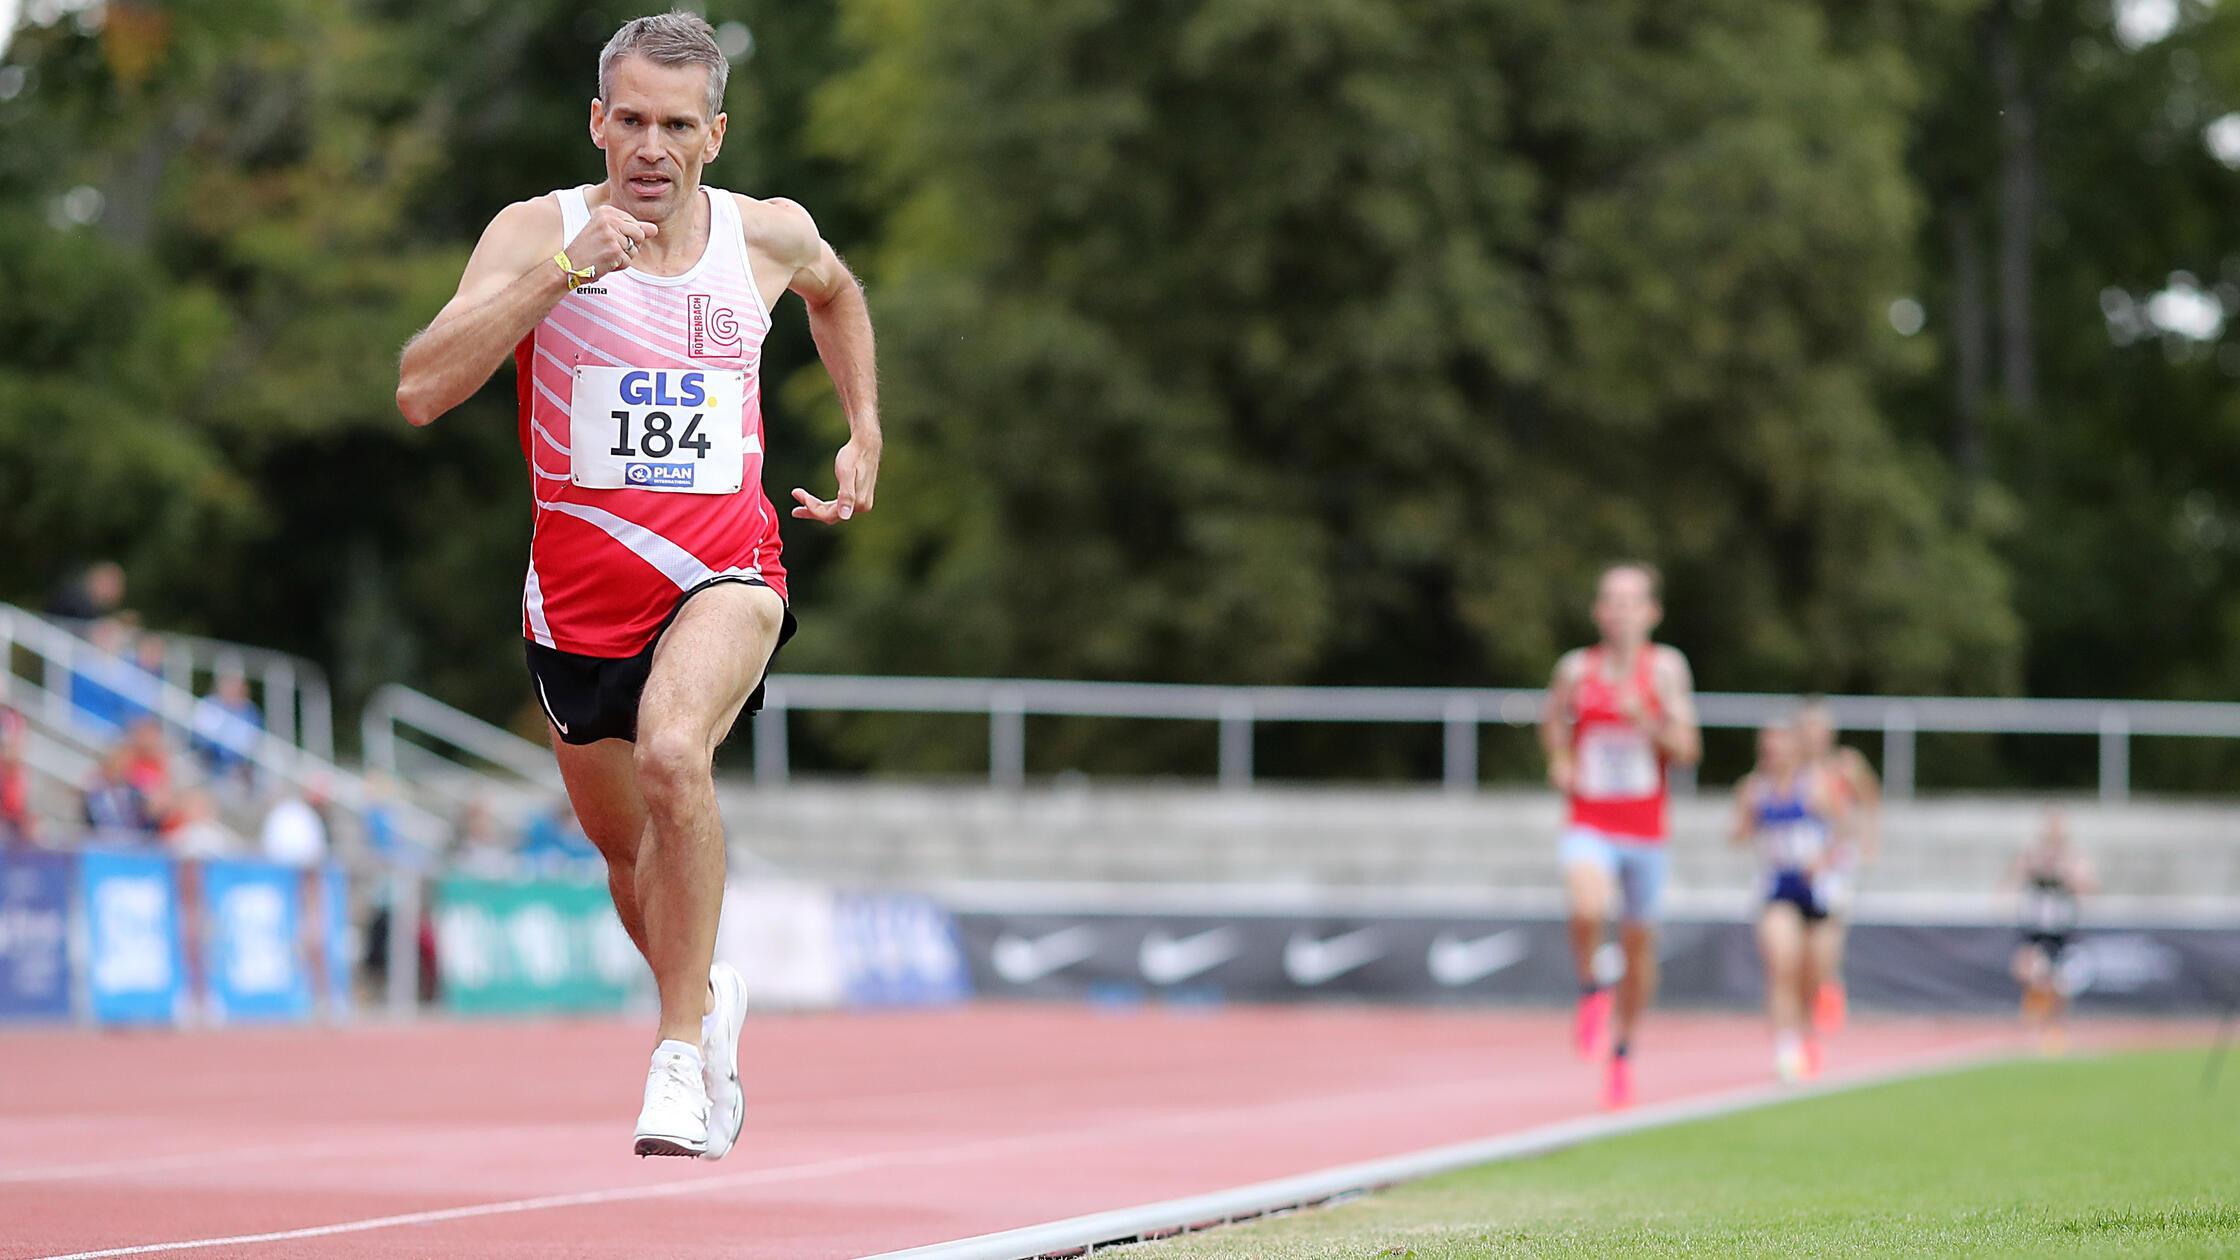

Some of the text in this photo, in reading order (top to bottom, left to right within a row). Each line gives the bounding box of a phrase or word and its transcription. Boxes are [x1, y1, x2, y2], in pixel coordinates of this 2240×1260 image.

[576, 286, 608, 295] erima
[610, 410, 712, 459] 184
[653, 466, 692, 479] PLAN
